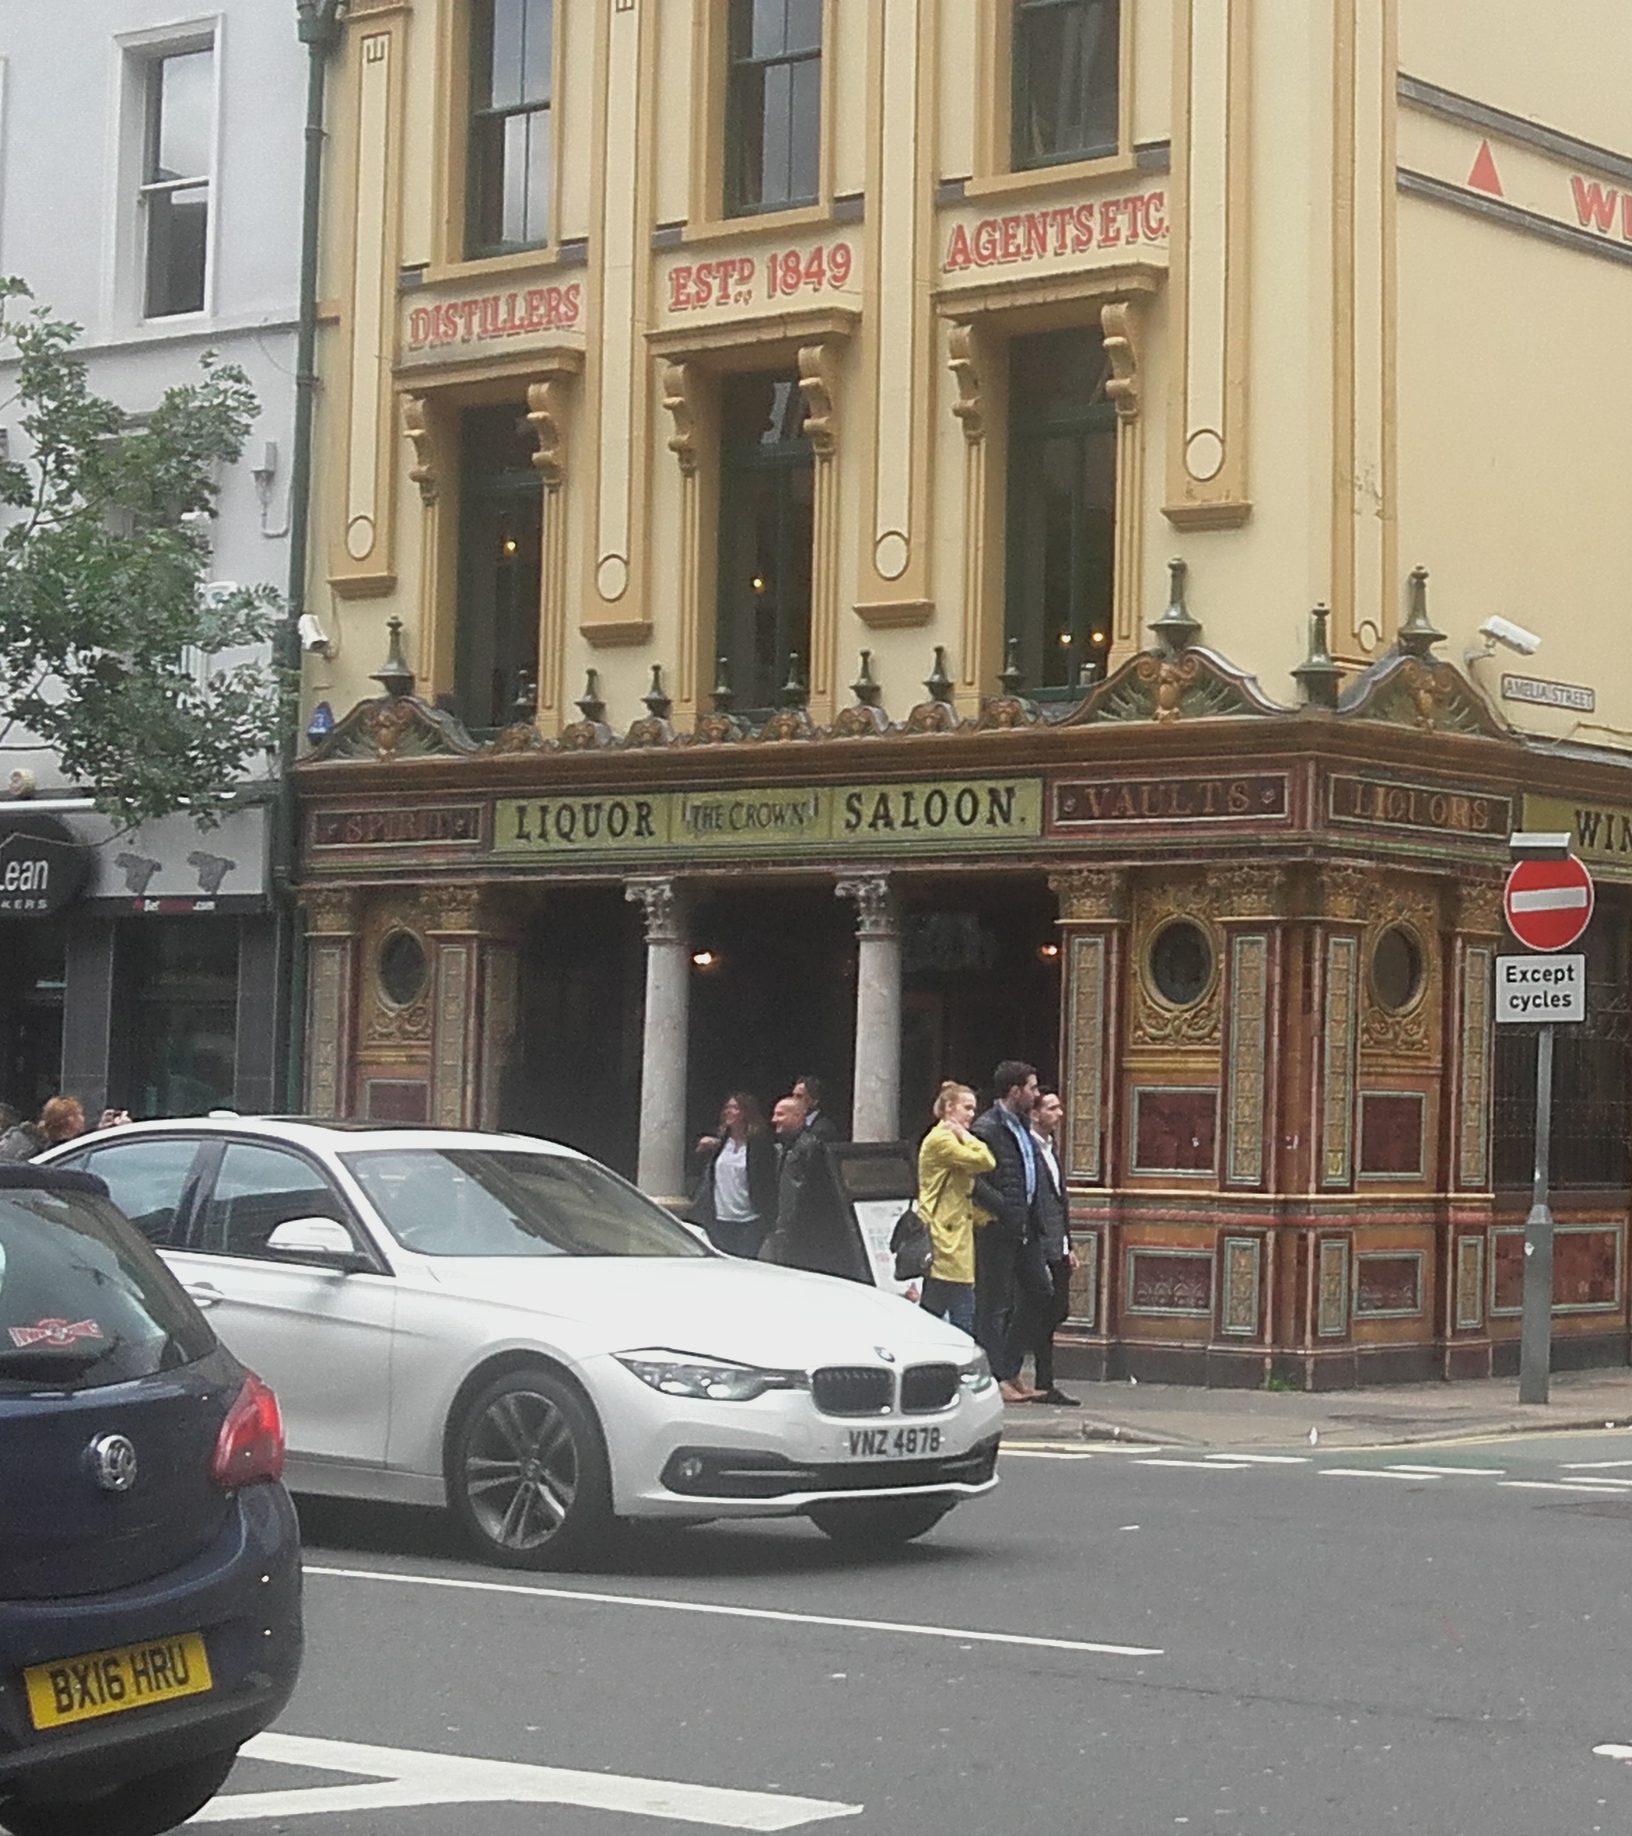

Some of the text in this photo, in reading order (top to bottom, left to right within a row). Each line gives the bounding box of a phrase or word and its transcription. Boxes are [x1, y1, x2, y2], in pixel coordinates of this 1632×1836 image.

[945, 191, 1170, 272] AGENTS ETC.
[768, 243, 852, 298] 1849
[411, 284, 580, 349] DISTILLERS
[1504, 679, 1593, 708] AMELIA STREET
[1085, 780, 1250, 818] VAULTS
[515, 800, 656, 843] LIQUOR
[728, 800, 807, 831] CROWN
[0, 860, 48, 891] ean
[1506, 964, 1574, 985] Except
[1509, 991, 1572, 1012] cycles
[893, 1427, 940, 1457] 4878
[50, 1642, 189, 1714] BX16 HRU
